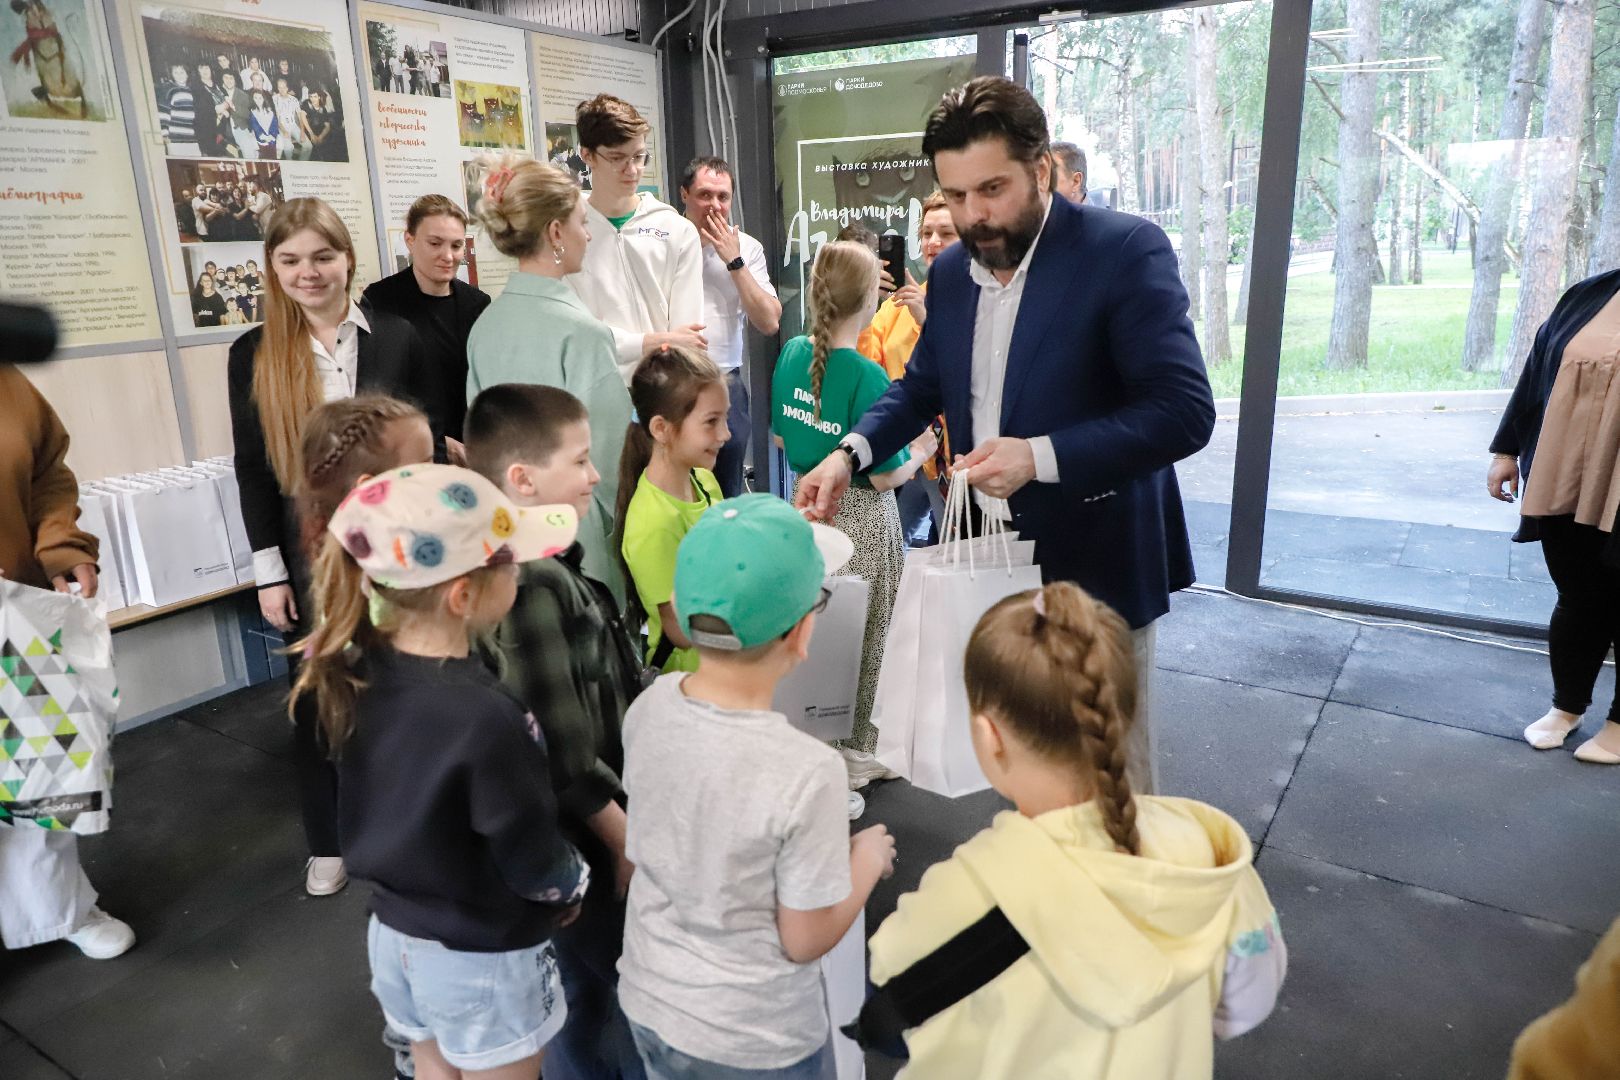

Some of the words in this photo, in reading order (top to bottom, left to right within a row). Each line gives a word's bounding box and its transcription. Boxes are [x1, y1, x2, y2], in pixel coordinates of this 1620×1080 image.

[815, 162, 868, 173] выставка
[872, 158, 931, 171] художник
[0, 186, 86, 205] иблиография
[809, 199, 910, 229] Владимира
